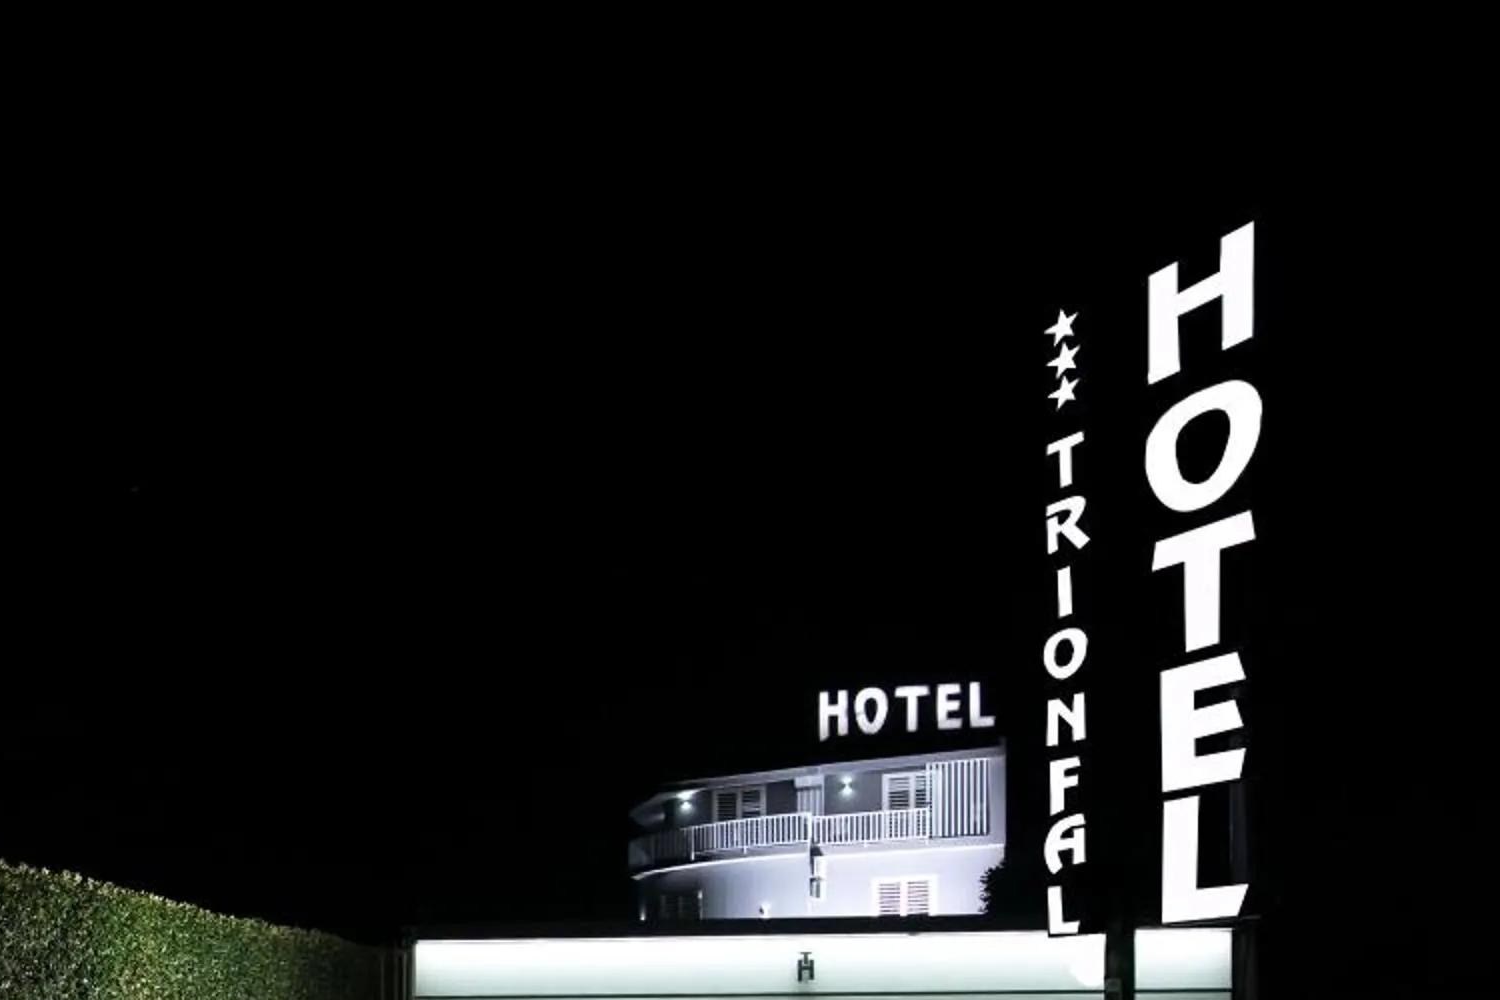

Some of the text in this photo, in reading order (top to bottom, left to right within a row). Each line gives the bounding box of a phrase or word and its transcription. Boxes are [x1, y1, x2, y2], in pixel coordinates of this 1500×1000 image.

[817, 681, 996, 742] HOTEL
[1042, 431, 1090, 937] TRIONFAL
[1145, 220, 1263, 925] HOTEL
